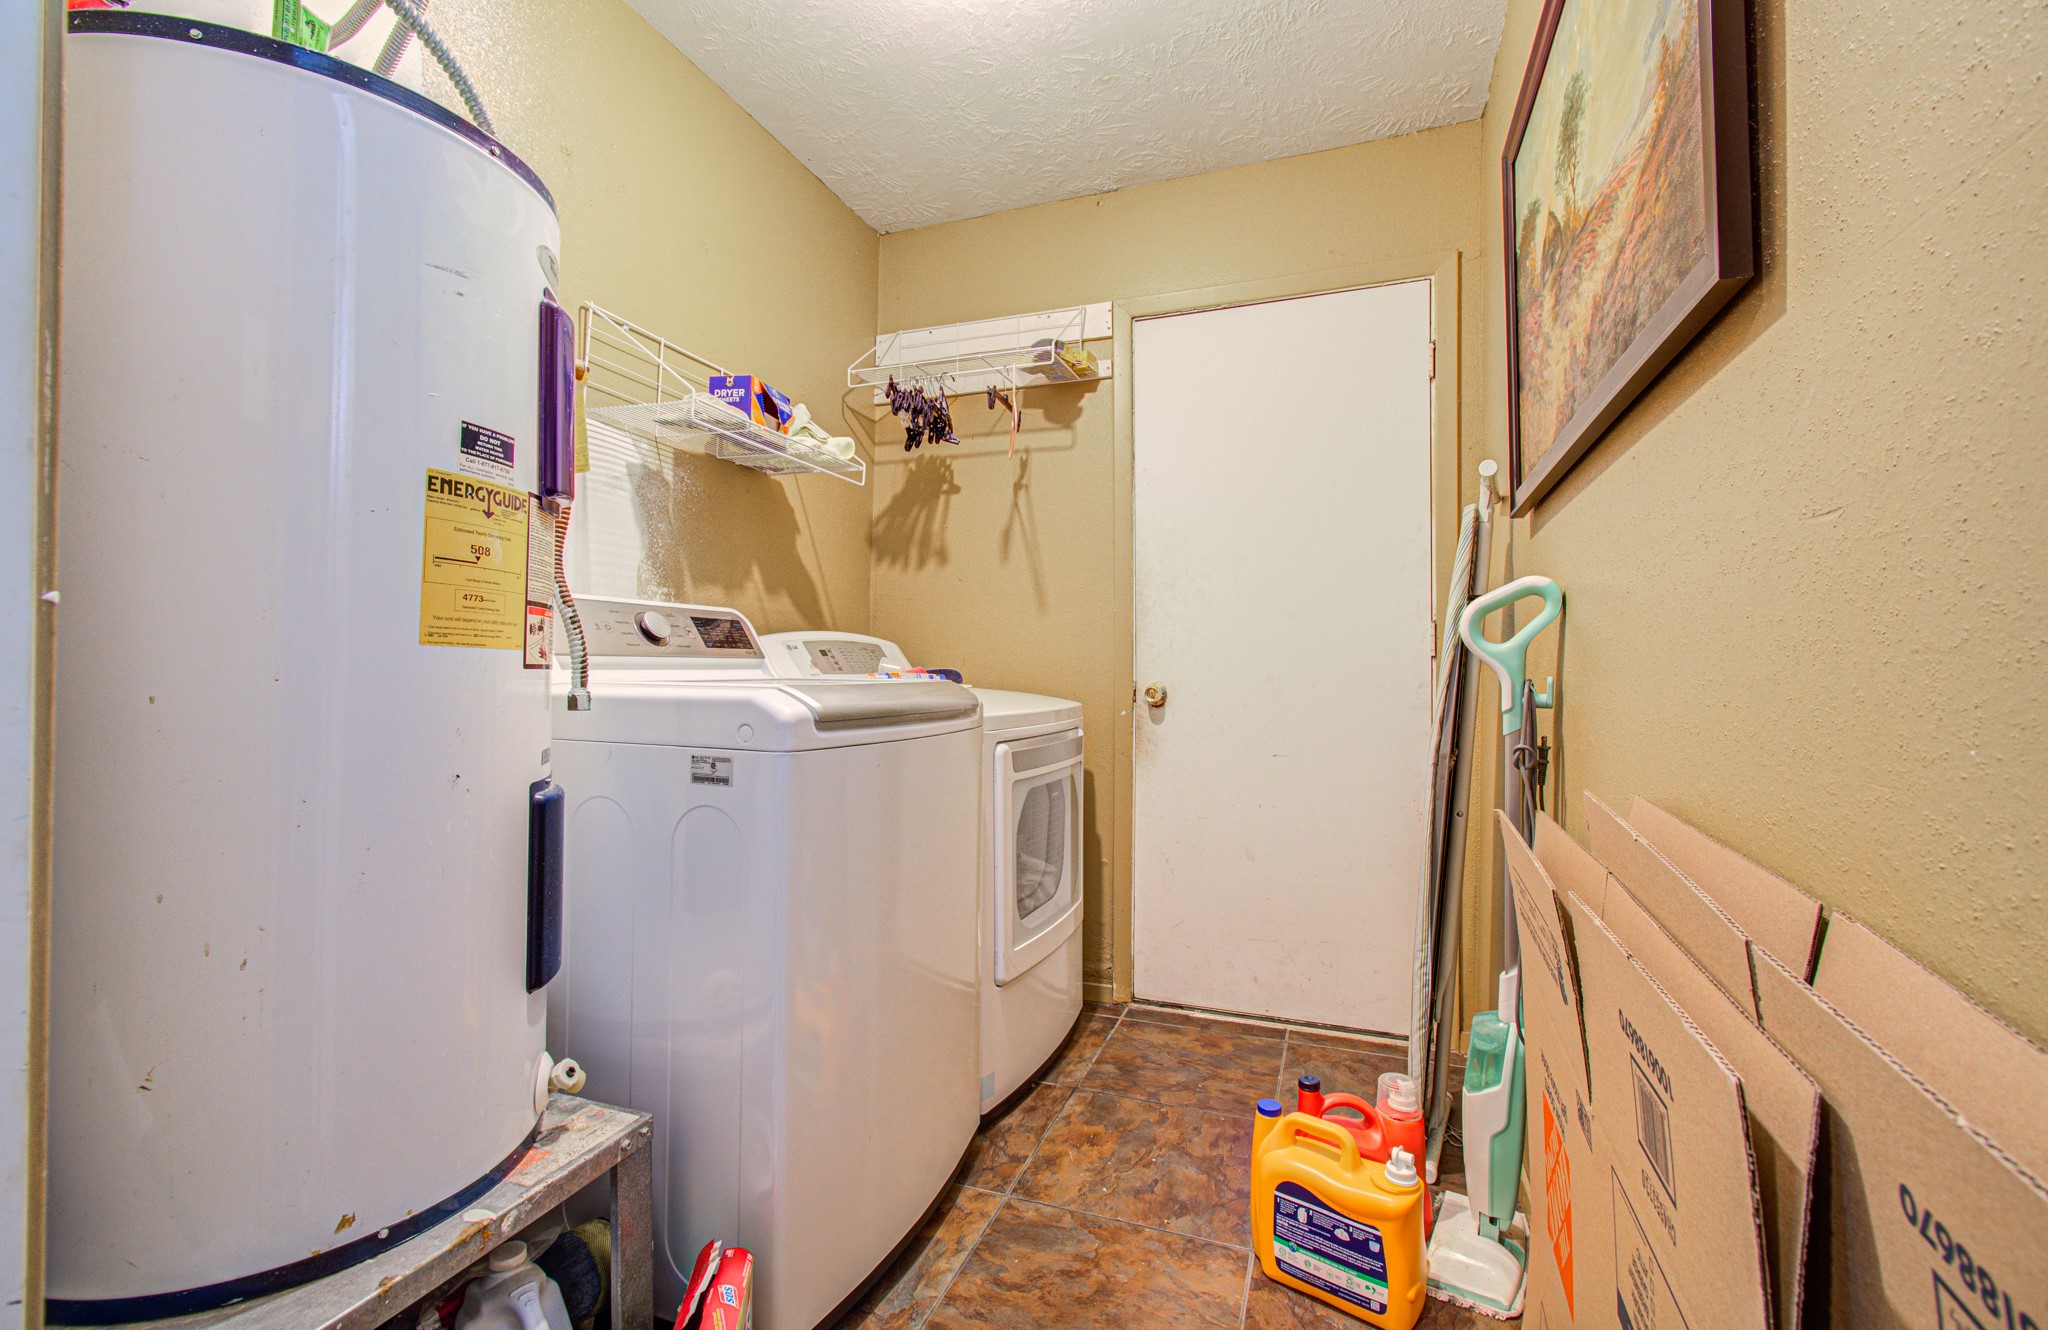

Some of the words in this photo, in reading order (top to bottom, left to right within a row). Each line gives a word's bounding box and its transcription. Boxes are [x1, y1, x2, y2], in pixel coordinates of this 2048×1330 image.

[714, 389, 745, 398] DRYER
[490, 438, 501, 446] NOT
[477, 450, 490, 459] PLACE
[428, 475, 527, 519] ENERGYGUIDE
[454, 527, 474, 535] Estimated
[470, 544, 491, 556] 508
[463, 593, 484, 602] 4773
[724, 1286, 735, 1304] SOS
